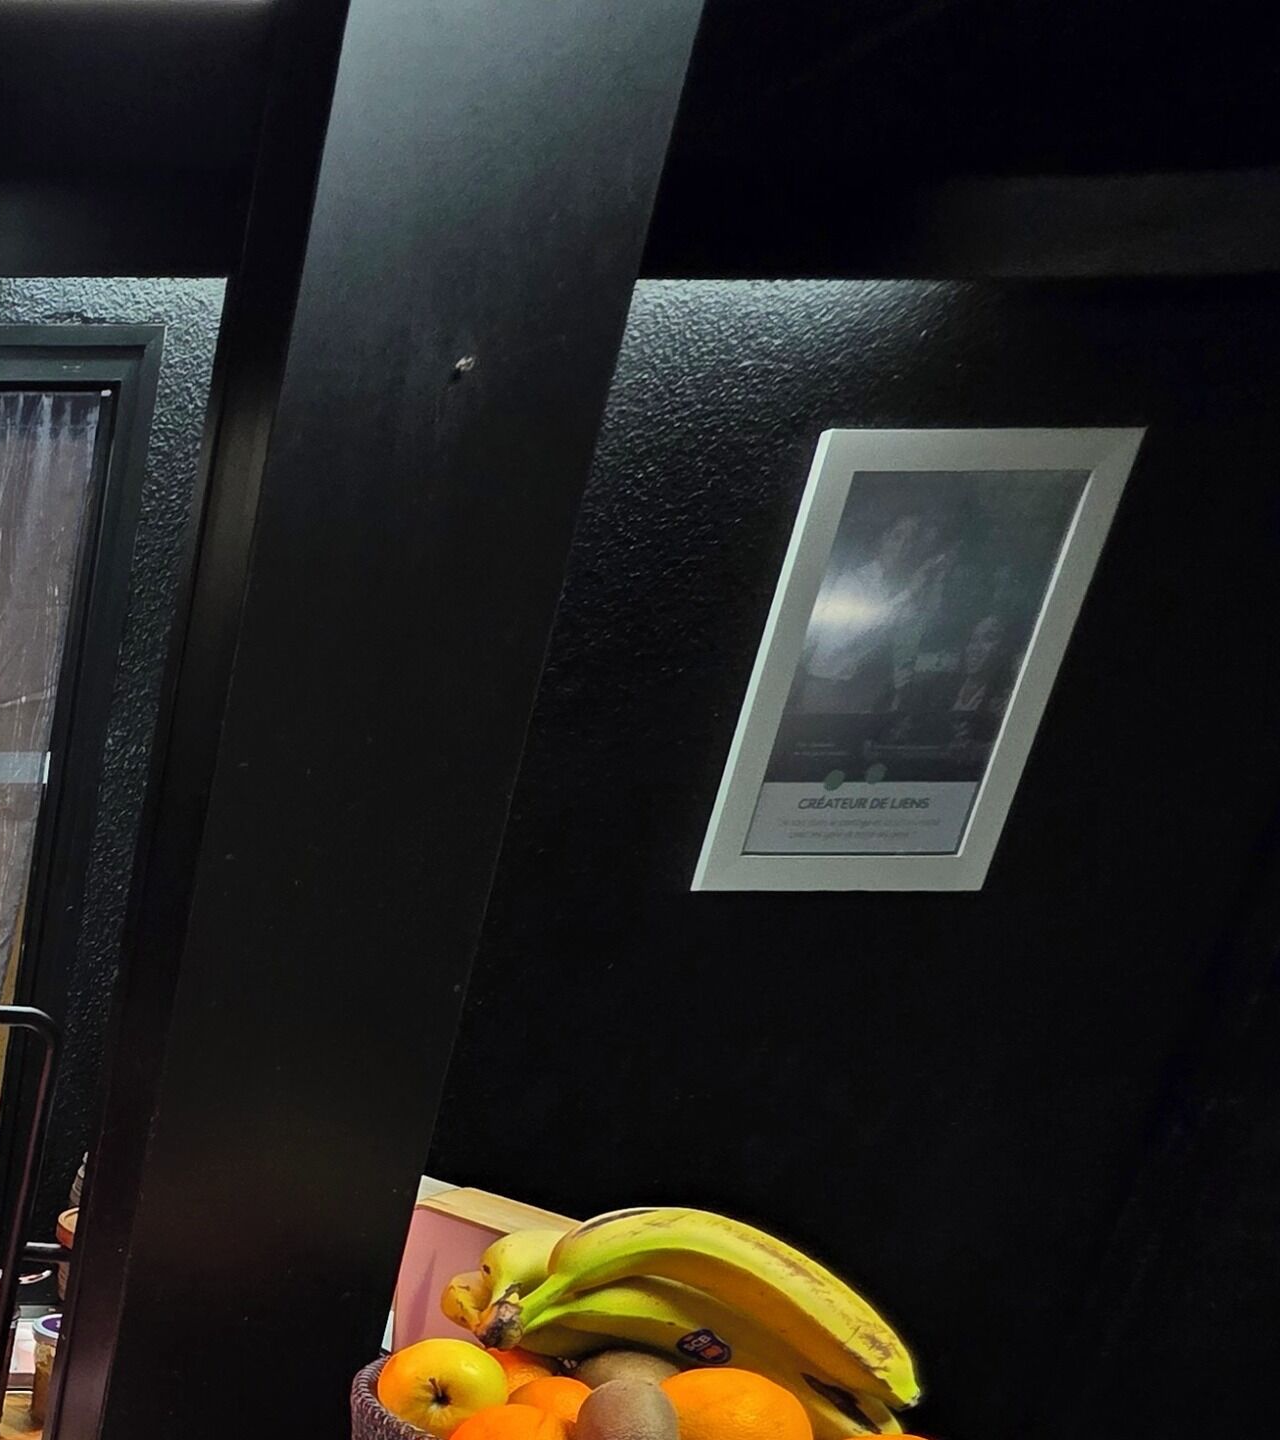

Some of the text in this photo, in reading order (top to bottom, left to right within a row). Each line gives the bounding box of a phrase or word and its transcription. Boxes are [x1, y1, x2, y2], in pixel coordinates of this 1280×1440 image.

[797, 796, 930, 810] CRÉATEUR DE LIENS
